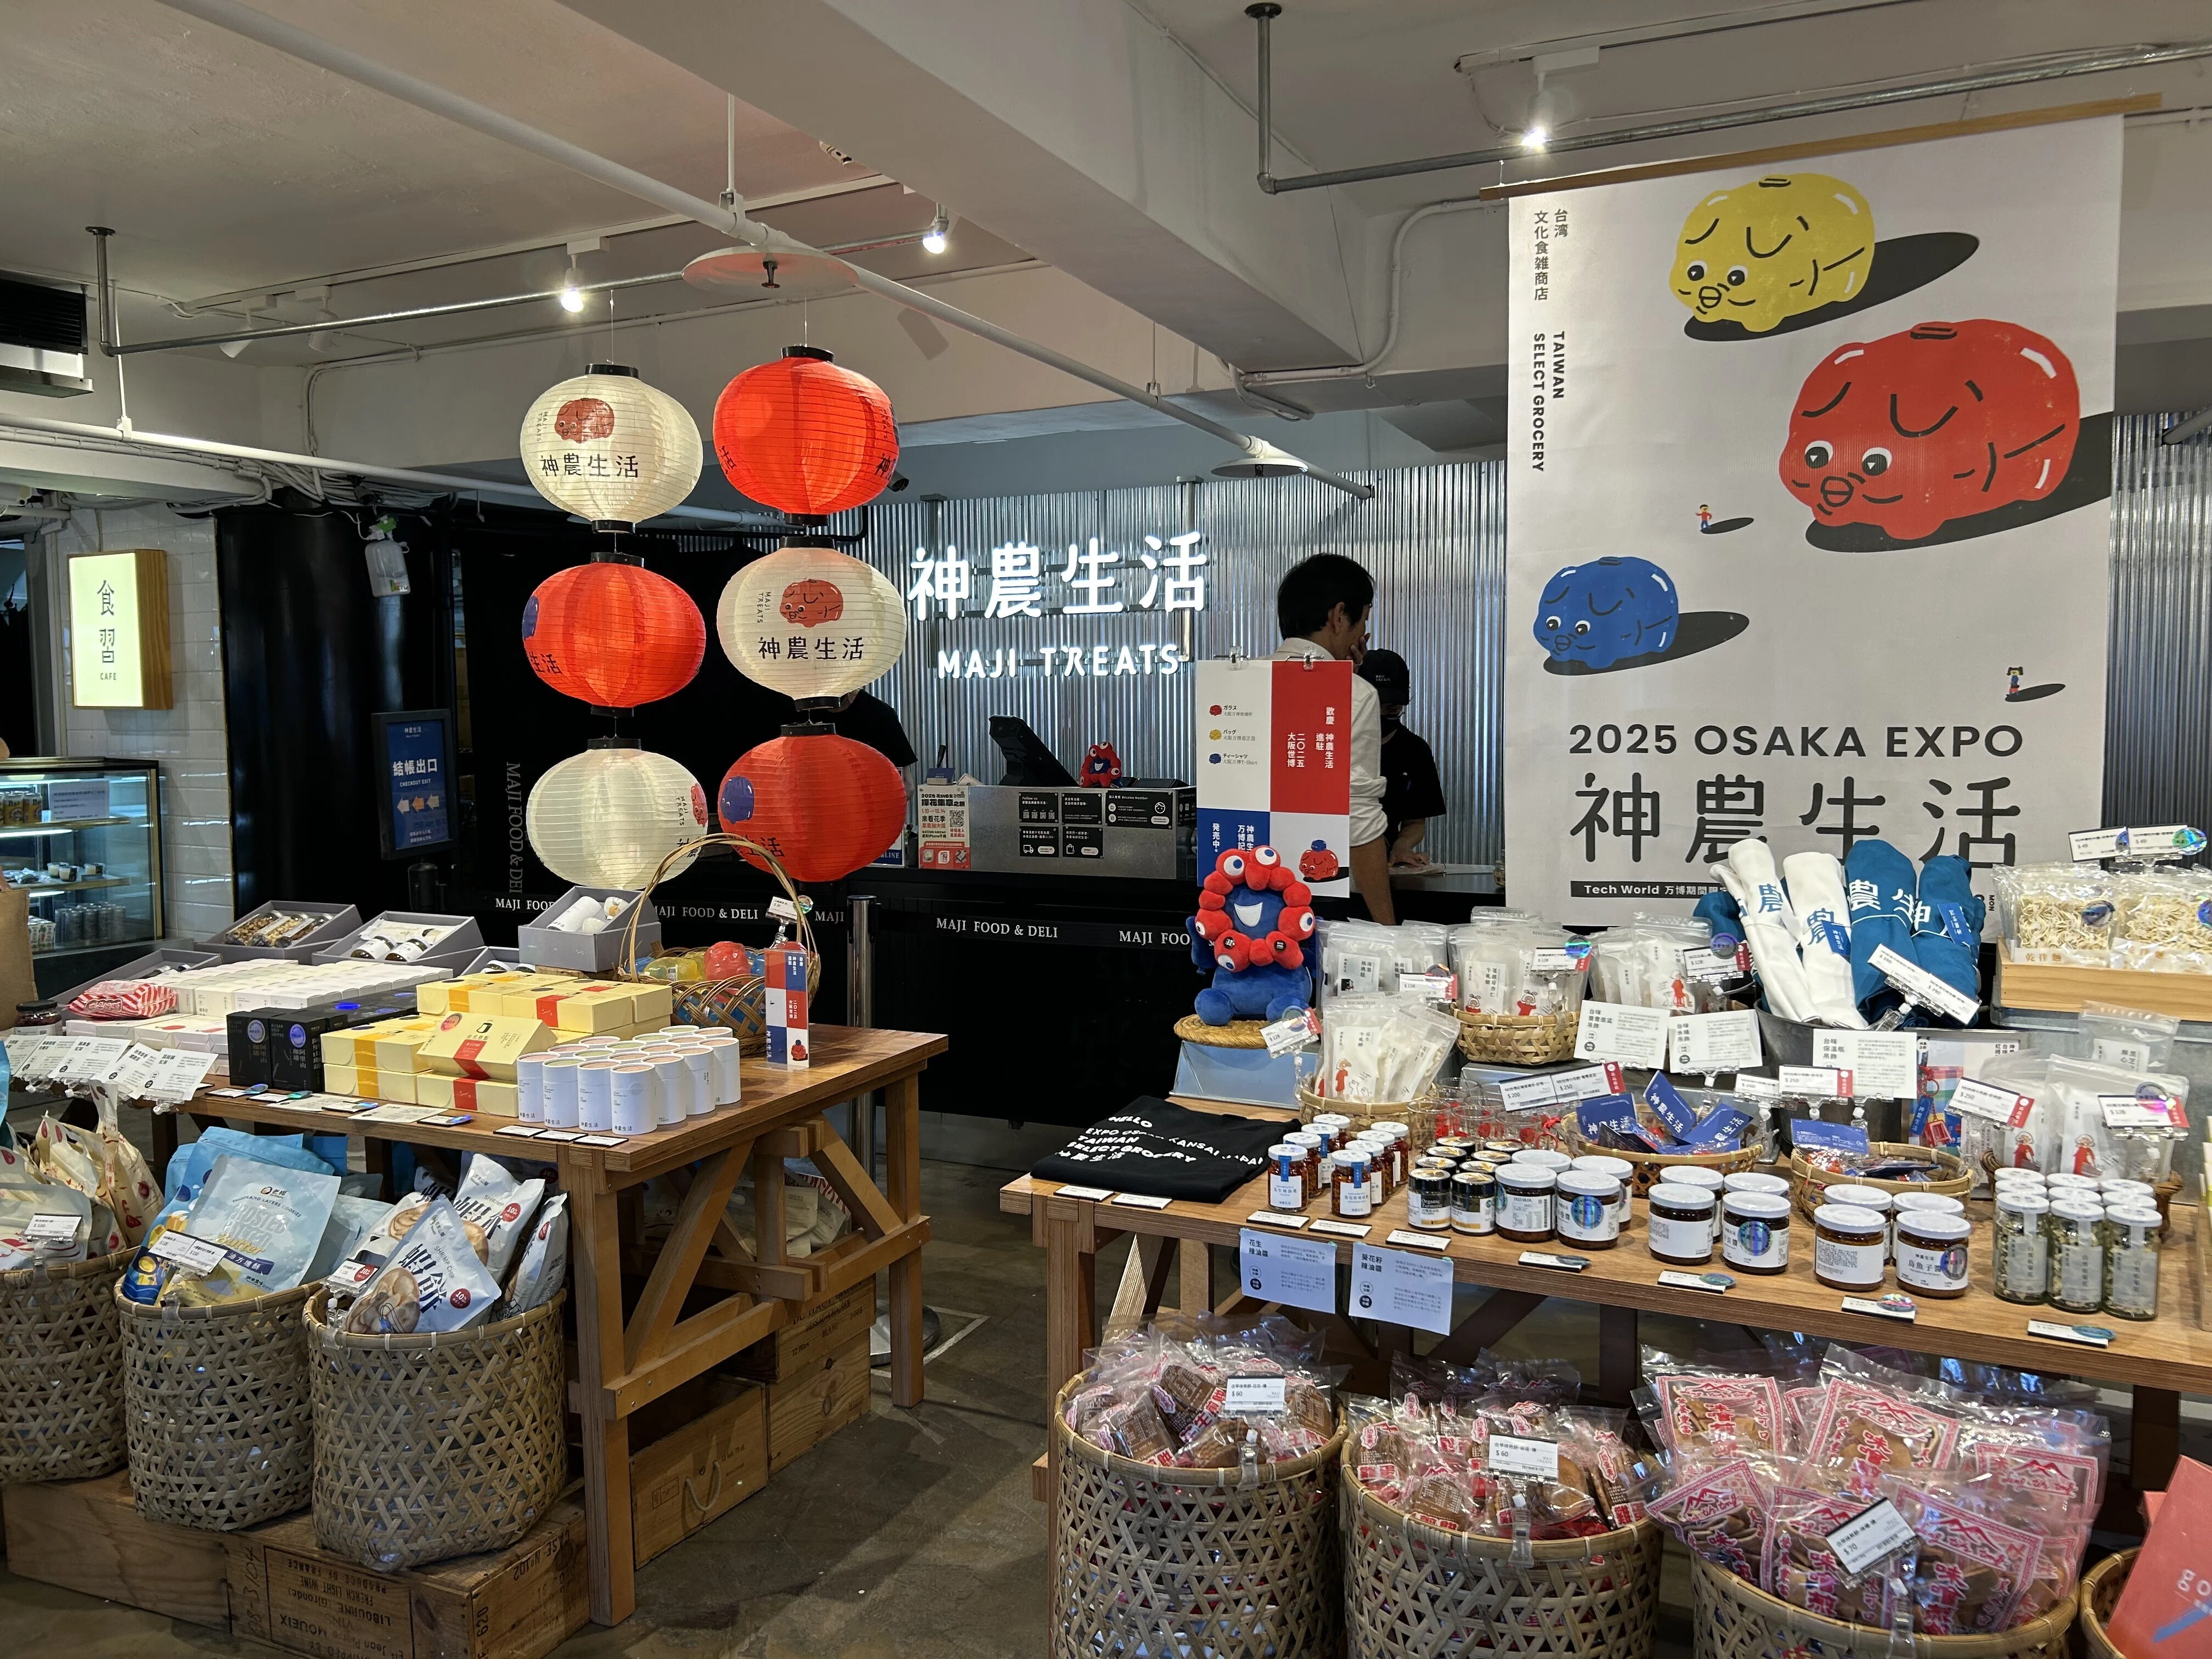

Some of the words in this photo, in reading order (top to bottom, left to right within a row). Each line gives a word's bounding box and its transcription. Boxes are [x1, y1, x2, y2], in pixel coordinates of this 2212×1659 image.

[1554, 208, 1568, 238] 台湾
[1533, 332, 1546, 391] SELECT
[1553, 330, 1565, 399] TAIWAN
[1532, 394, 1545, 472] GROCERY
[540, 453, 639, 478] 神農生活
[908, 531, 1209, 620] 神農生活
[97, 579, 116, 664] 食習
[758, 636, 865, 661] 神農生活
[938, 648, 1017, 679] MAJI
[1040, 644, 1178, 676] TREATS
[100, 672, 117, 681] CAFE
[1287, 732, 1296, 768] 大阪世博
[1325, 733, 1334, 769] 神農生活
[1569, 724, 1677, 755] 2025
[1694, 725, 1866, 758] OSAKA
[1886, 724, 2023, 758] EXPO
[393, 758, 438, 777] 結帳出口
[1570, 772, 2021, 869] 神農生活
[1584, 885, 1617, 895] Tech
[1620, 885, 1660, 895] World
[495, 898, 521, 910] MAJI
[682, 906, 715, 918] FOOD
[719, 908, 729, 919] &
[731, 908, 759, 920] DELI
[815, 910, 845, 923] MAJI
[936, 918, 967, 932] MAJI
[974, 921, 1010, 935] FOOD
[1014, 924, 1024, 936] &
[1028, 926, 1058, 939] DELI
[1119, 930, 1153, 945] MAJI
[1161, 933, 1192, 945] FOO
[1108, 1115, 1153, 1128] HELLO
[1650, 1092, 1684, 1133] 神農生活
[1066, 1142, 1121, 1153] SELECT
[1077, 1135, 1140, 1144] TAIWAN
[1169, 1137, 1220, 1156] KANSAI
[262, 1198, 281, 1207] LAYERS
[281, 1204, 302, 1218] COOKIES
[215, 1232, 266, 1255] Butter
[1249, 1238, 1262, 1247] 花生
[434, 1245, 450, 1268] SHRIMP
[446, 1265, 455, 1279] CHIP
[1842, 1543, 1858, 1556] $70
[287, 1558, 321, 1576] FRANCE
[329, 1569, 338, 1579] OF
[300, 1575, 319, 1590] WINE
[323, 1582, 342, 1597] LIGHT
[345, 1574, 387, 1594] PRODUCE
[346, 1590, 374, 1606] FRENCH
[337, 1602, 391, 1627] LIBOURNE
[280, 1613, 327, 1638] MOUEIX
[364, 1640, 387, 1657] Jean
